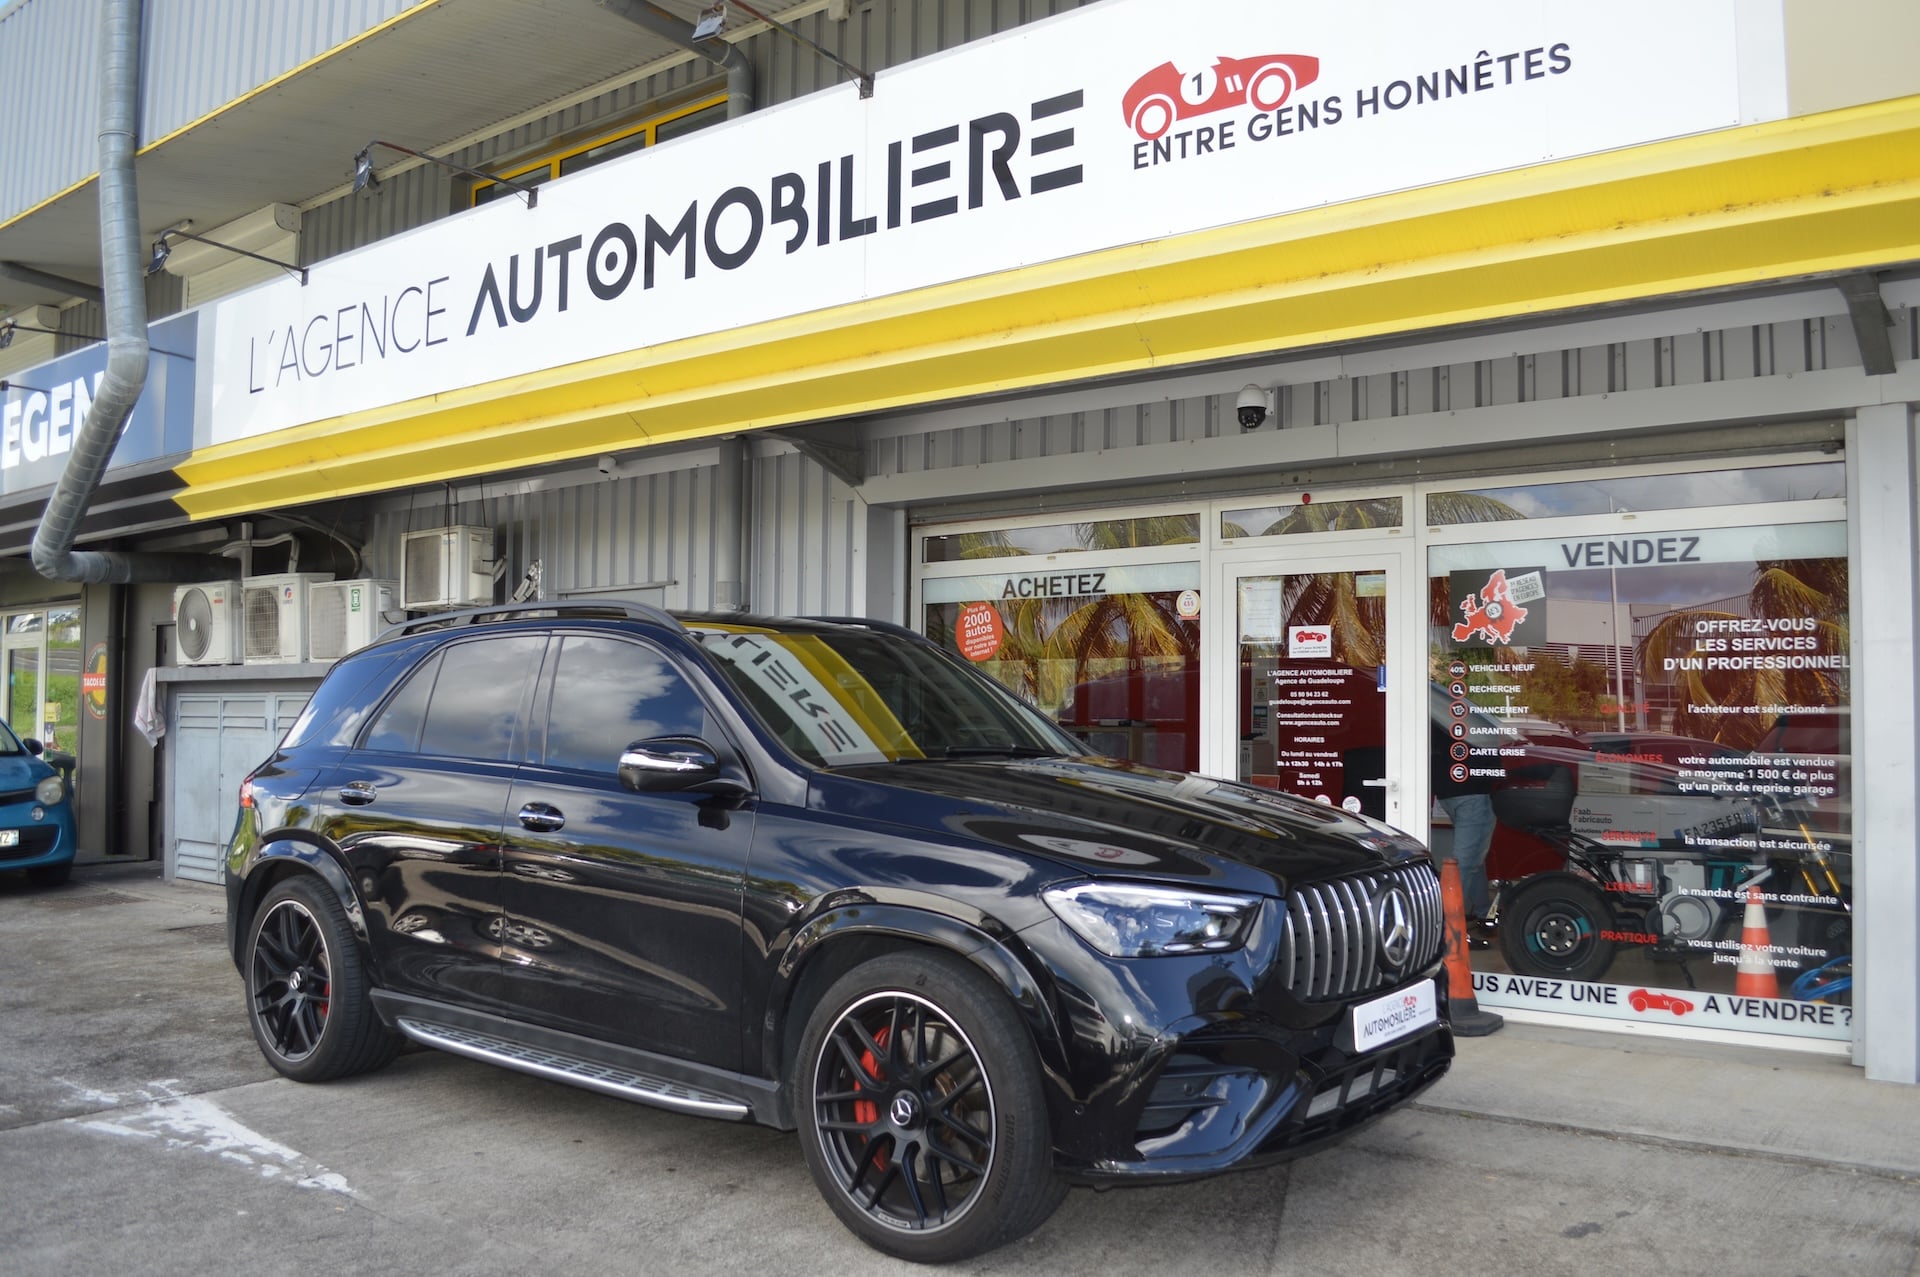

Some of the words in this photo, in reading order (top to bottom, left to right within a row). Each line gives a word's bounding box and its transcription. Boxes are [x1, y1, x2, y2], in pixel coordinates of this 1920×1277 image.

[1191, 72, 1203, 96] 1
[1133, 120, 1236, 170] ENTRE
[1247, 96, 1343, 142] GENS
[1356, 42, 1573, 118] HONNÊTES
[249, 276, 450, 394] L'AGENCE
[465, 89, 1084, 337] AUTOMOBILIERE
[2, 370, 134, 470] EGEN
[1561, 537, 1700, 568] VENDEZ
[1002, 573, 1106, 599] ACHETEZ
[964, 610, 991, 628] 2000
[1696, 617, 1816, 634] OFFREZ-VOUS
[965, 624, 993, 638] autos
[1695, 638, 1727, 652] LES
[1731, 636, 1817, 651] SERVICES
[1469, 664, 1510, 673] VEHICULE
[1512, 664, 1535, 672] NEUF
[1663, 657, 1702, 671] D'UN
[1707, 655, 1850, 670] PROFESSIONNEL
[1267, 669, 1298, 677] L'AGENCE
[1469, 685, 1521, 693] RECHERCHE
[1469, 706, 1529, 714] FINANCEMENT
[1688, 703, 1741, 714] l'acheteur
[1743, 704, 1760, 714] est
[1761, 703, 1826, 714] sélectionné
[1469, 727, 1518, 735] GARANTIES
[1469, 748, 1498, 756] CARTE
[1500, 748, 1526, 757] GRISE
[1678, 756, 1706, 765] votre
[1708, 755, 1771, 765] automobile
[1773, 757, 1790, 766] est
[1792, 756, 1835, 767] vendue
[1469, 769, 1506, 777] REPRISE
[1678, 770, 1692, 778] en
[1694, 770, 1745, 782] moyenne
[1781, 769, 1791, 780] €
[1792, 769, 1808, 780] de
[1809, 770, 1835, 783] plus
[1678, 782, 1709, 793] qu'un
[1711, 782, 1734, 793] prix
[1735, 782, 1751, 792] de
[1752, 783, 1792, 794] reprise
[1793, 785, 1834, 797] garage
[1573, 807, 1592, 815] Faab
[1573, 815, 1613, 824] Fabricauto
[1684, 834, 1695, 845] la
[1697, 836, 1757, 848] transaction
[1759, 839, 1776, 849] est
[1778, 839, 1831, 851] sécurisée
[1678, 885, 1689, 896] le
[1691, 887, 1732, 899] mandat
[1734, 888, 1751, 900] est
[1752, 892, 1777, 901] sans
[1780, 893, 1838, 905] contrainte
[1600, 930, 1658, 944] PRATIQUE
[1687, 939, 1713, 949] vous
[1715, 940, 1752, 951] utilisez
[1755, 944, 1784, 954] votre
[1786, 945, 1827, 957] voiture
[1755, 956, 1766, 965] la
[1768, 957, 1799, 969] vente
[1471, 973, 1499, 993] US
[1505, 978, 1563, 999] AVEZ
[1570, 984, 1617, 1005] UNE
[1704, 995, 1720, 1014] A
[1727, 997, 1834, 1025] VENDRE
